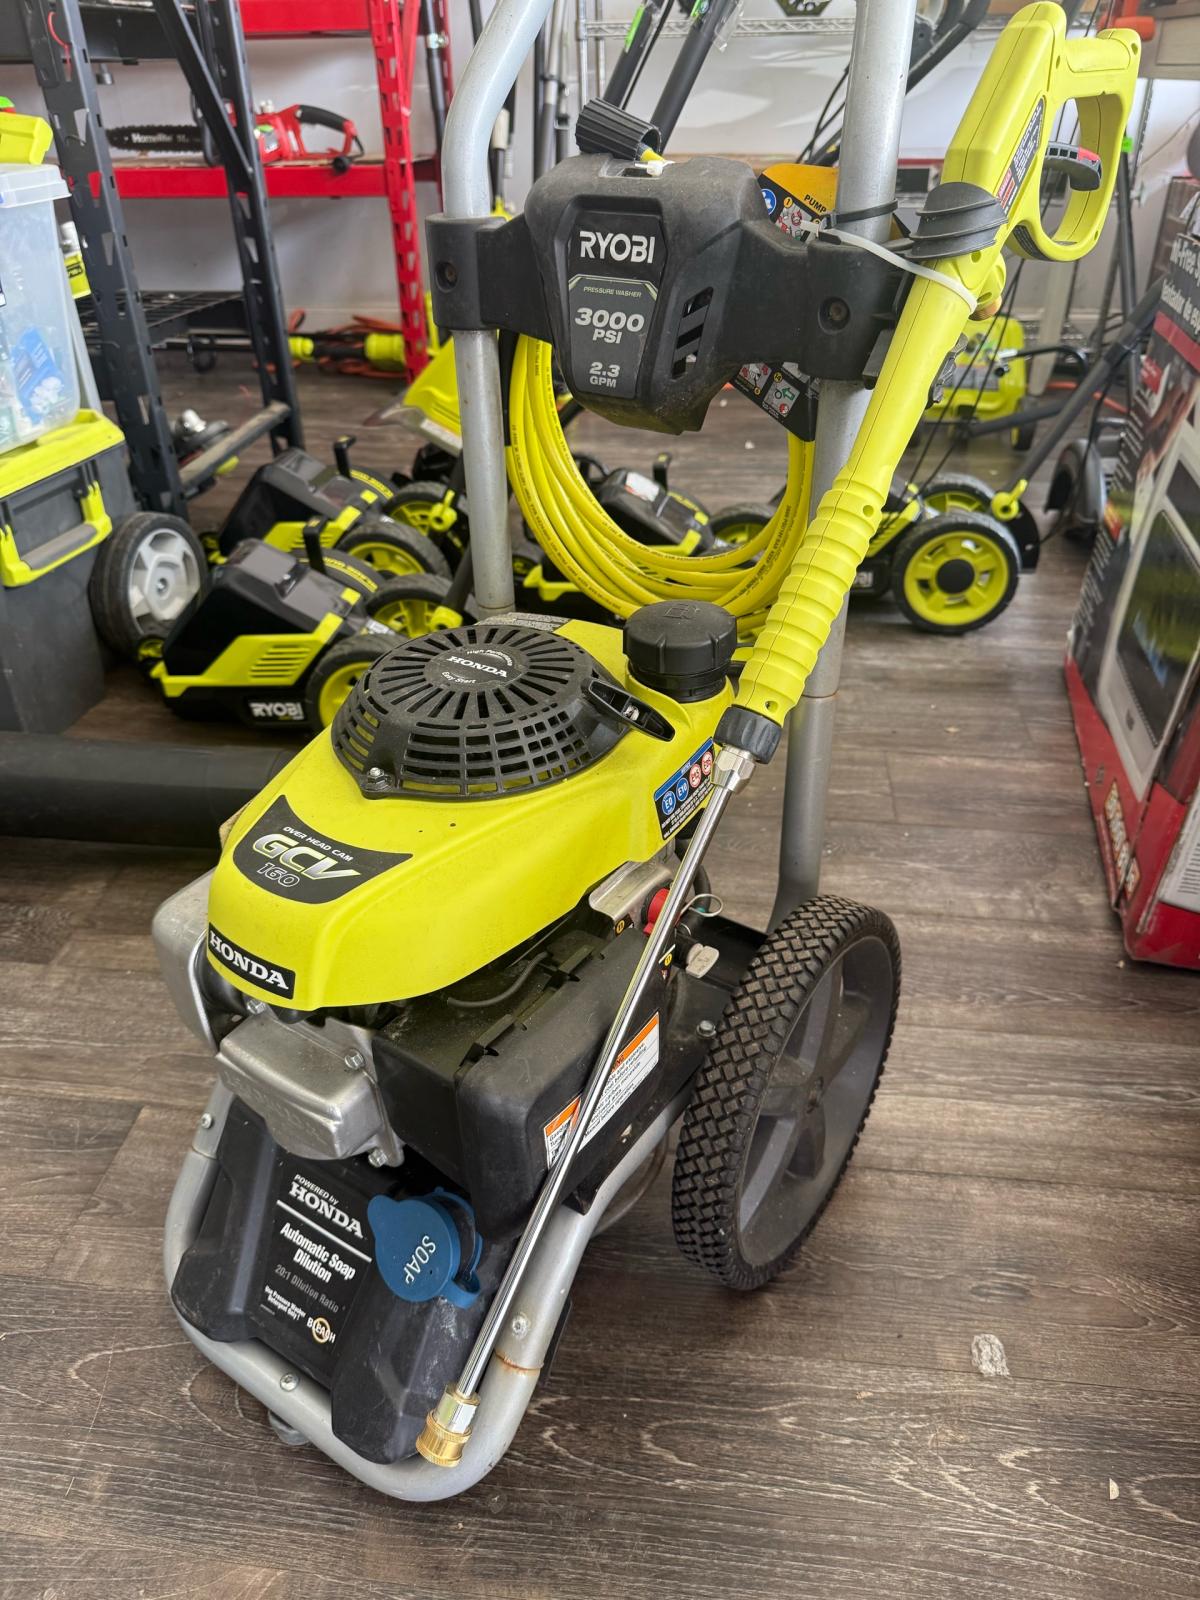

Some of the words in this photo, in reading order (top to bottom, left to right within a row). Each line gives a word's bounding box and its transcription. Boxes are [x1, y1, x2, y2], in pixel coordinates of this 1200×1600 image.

[804, 194, 827, 213] PUMP
[579, 231, 656, 264] RYOBI
[583, 286, 614, 295] PRESSURE
[615, 290, 642, 298] WASHER
[574, 307, 645, 333] 3000
[592, 329, 623, 344] PSI
[589, 361, 621, 378] 2.3
[589, 376, 617, 389] GPM
[441, 671, 454, 682] Easy
[446, 655, 508, 678] HONDA
[249, 702, 304, 718] RYOBI
[252, 833, 361, 881] GCV
[282, 826, 308, 840] OVER
[306, 836, 332, 852] HEAD
[331, 848, 354, 863] CAM
[256, 862, 301, 888] 160
[208, 931, 289, 991] HONDA
[293, 1174, 330, 1199] POWERED
[329, 1195, 339, 1205] by
[289, 1181, 364, 1239] HONDA
[280, 1222, 330, 1262] Automatic
[328, 1252, 356, 1281] Soap
[404, 1235, 437, 1287] SOAP
[293, 1248, 333, 1283] Dilution
[274, 1264, 292, 1280] 20:1
[290, 1274, 319, 1300] Dilution
[319, 1293, 340, 1314] Ratio
[306, 1317, 337, 1344] BLEACH
